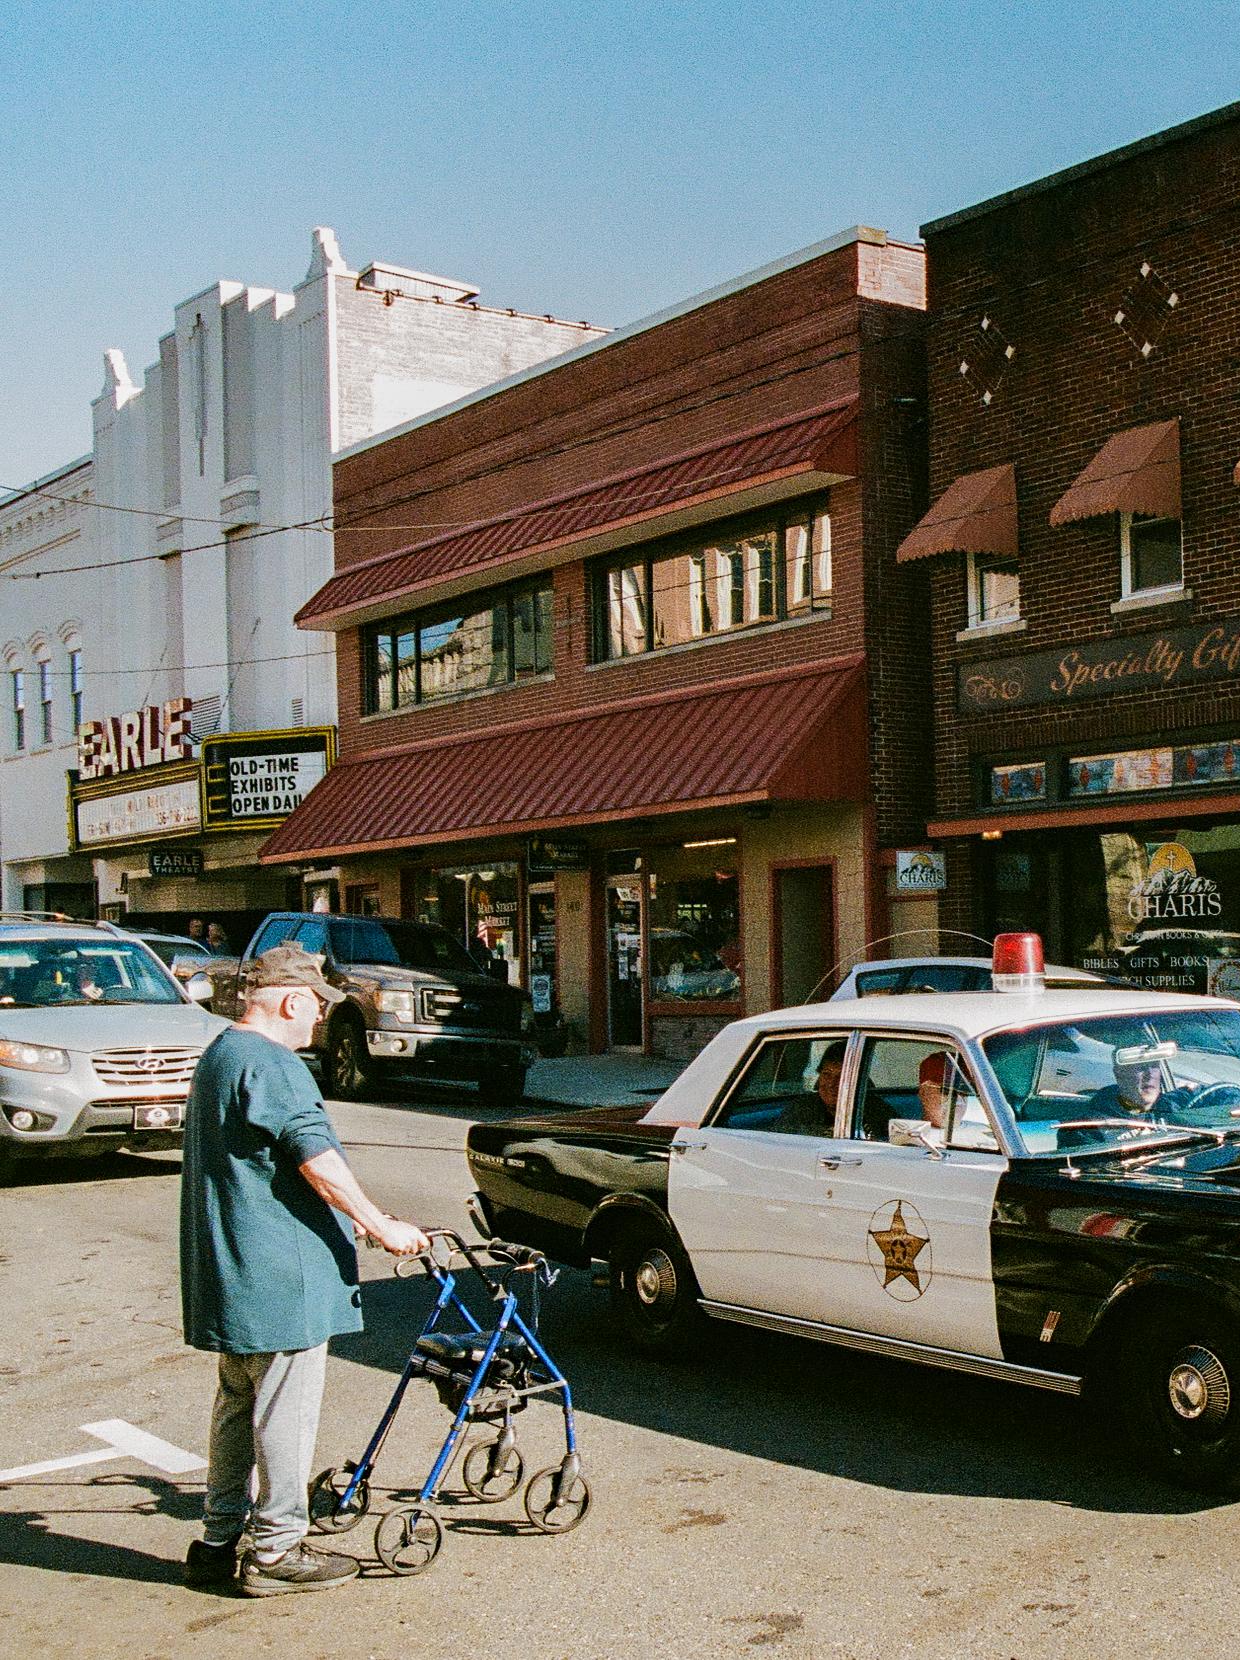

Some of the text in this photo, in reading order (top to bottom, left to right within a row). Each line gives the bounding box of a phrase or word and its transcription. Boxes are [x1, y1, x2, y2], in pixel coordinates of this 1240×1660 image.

[1051, 638, 1183, 696] Specialty
[78, 698, 191, 780] EARLE
[230, 757, 299, 776] OLD-TIME
[231, 775, 297, 795] EXHIBITS
[232, 796, 270, 813] OPEN
[153, 855, 200, 866] EARLE
[900, 870, 944, 883] CHARIS
[1127, 892, 1222, 920] CHARIS
[1083, 955, 1209, 969] BIBLES GIFTS BOOKS
[1144, 975, 1196, 987] SUPPLIES
